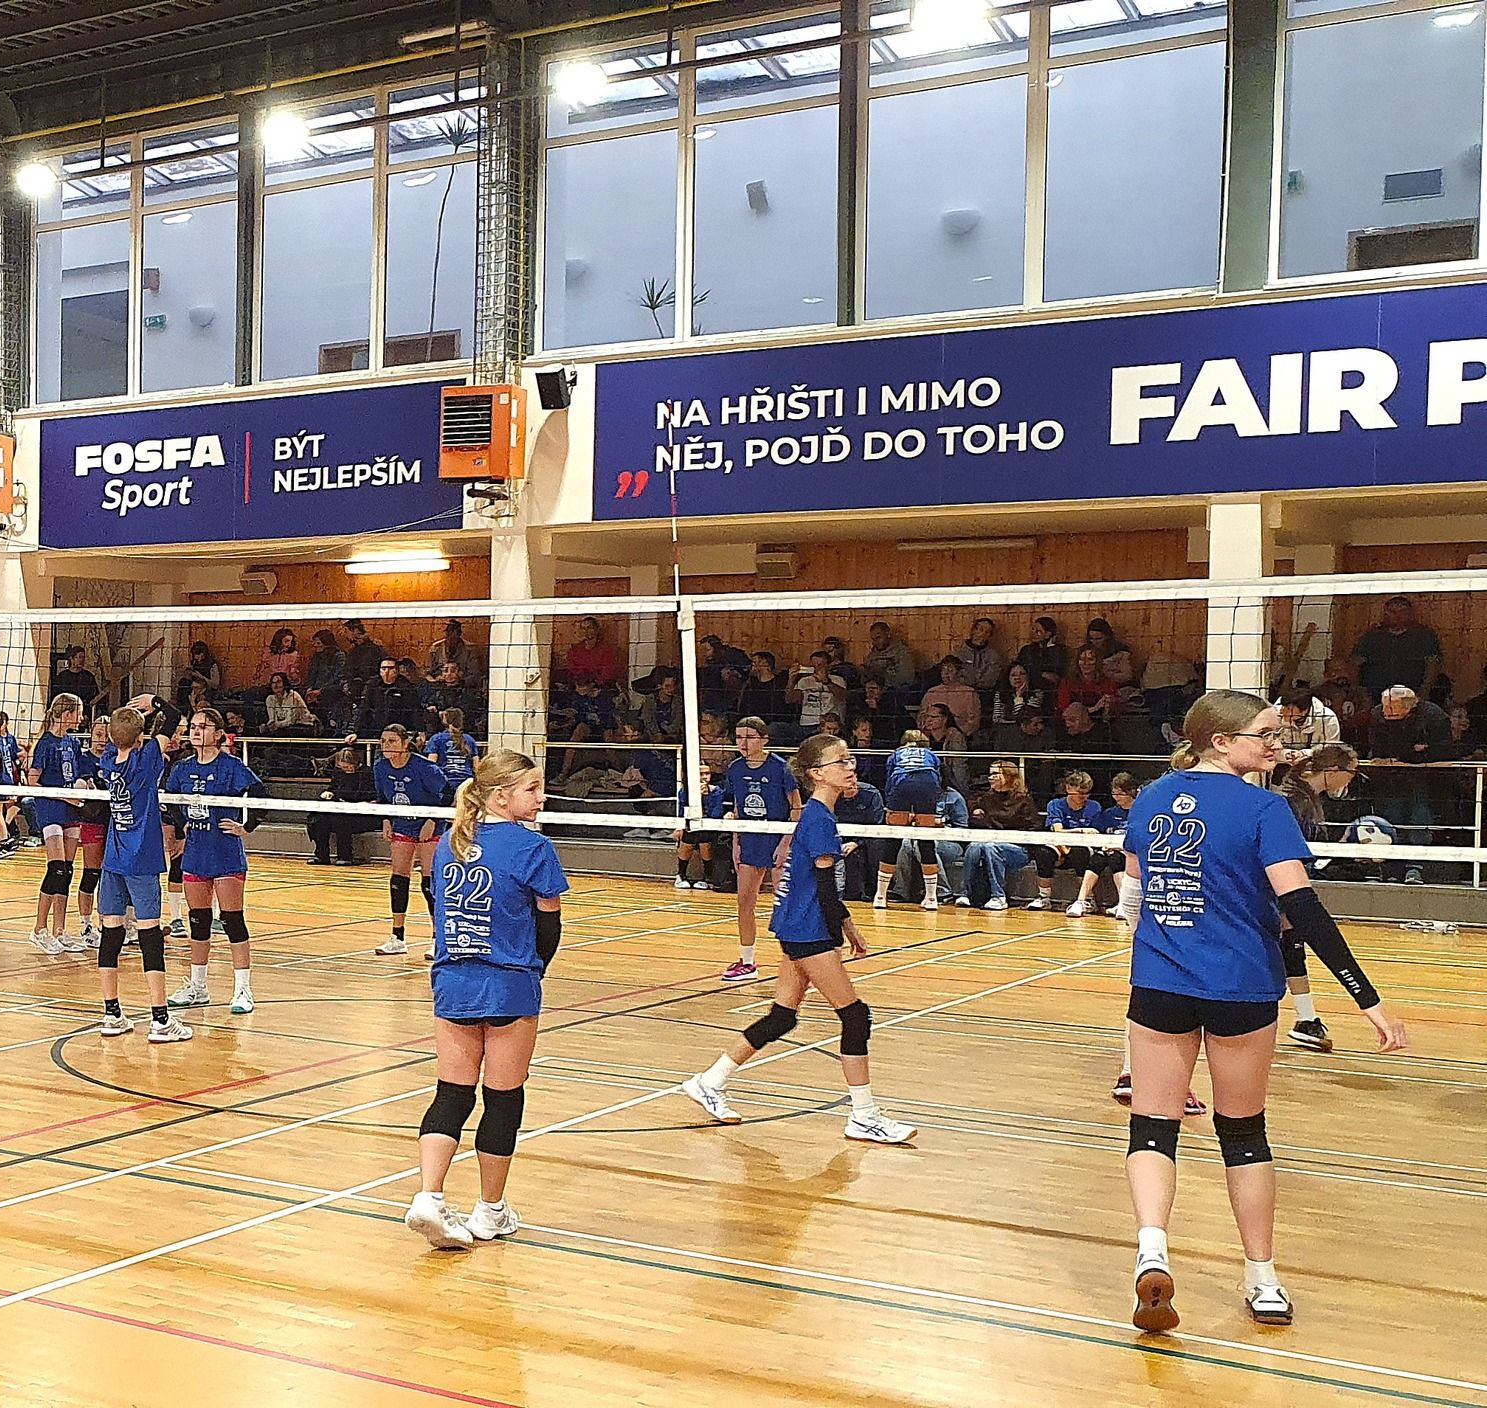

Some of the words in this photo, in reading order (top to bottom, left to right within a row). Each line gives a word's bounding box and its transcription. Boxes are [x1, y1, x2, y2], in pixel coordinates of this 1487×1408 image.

[656, 400, 710, 430] NA
[720, 384, 844, 425] HŘIŠTI
[857, 391, 867, 416] I
[881, 377, 1002, 414] MIMO
[1109, 348, 1399, 446] FAIR
[75, 434, 225, 477] FOSFA
[273, 429, 326, 462] BÝT
[655, 435, 735, 475] NĚJ,
[745, 427, 851, 468] POJĎ
[863, 428, 926, 461] DO
[937, 420, 1065, 456] TOHO
[102, 476, 193, 516] Sport
[273, 455, 421, 494] NEJLEPŠÍM
[1148, 814, 1206, 867] 22
[443, 862, 492, 911] 22
